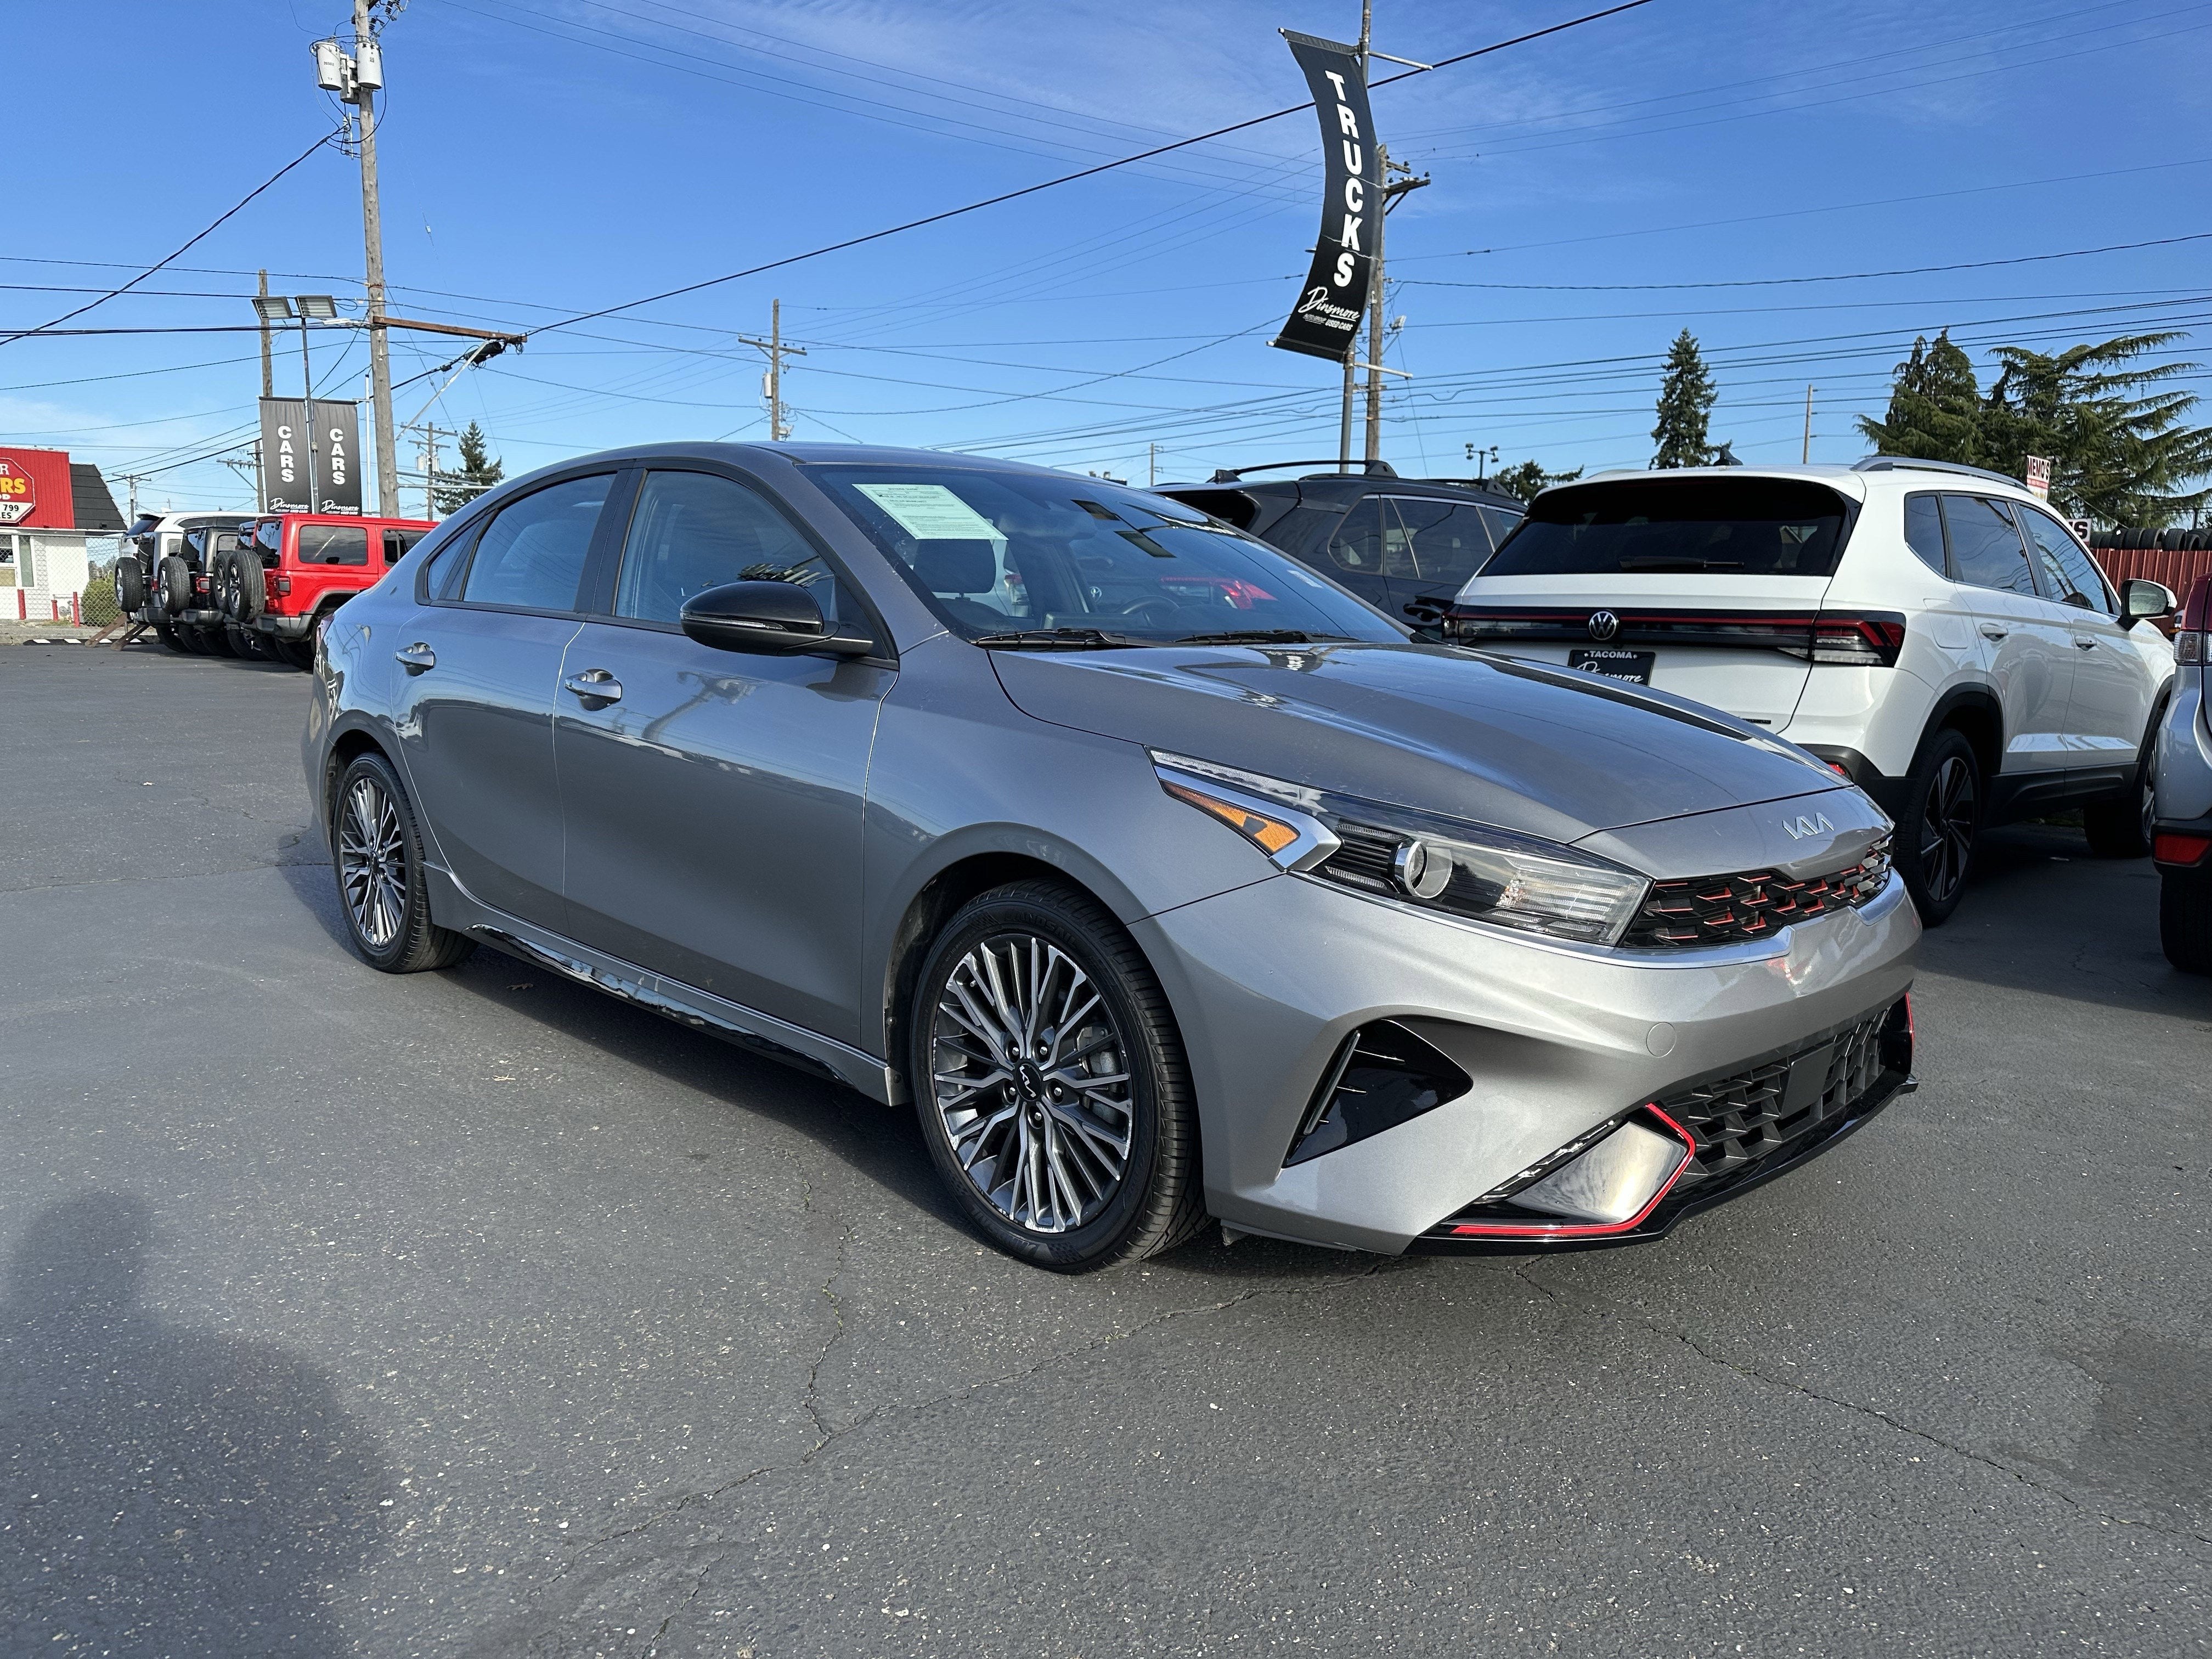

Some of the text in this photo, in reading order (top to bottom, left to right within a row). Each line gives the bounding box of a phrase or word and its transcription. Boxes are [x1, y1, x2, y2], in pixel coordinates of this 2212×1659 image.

[1325, 70, 1363, 287] TRUCKS
[1297, 286, 1361, 319] Dinsmore
[278, 425, 294, 483] CARS
[329, 428, 345, 485] CARS
[2028, 457, 2050, 481] MEMO'S
[2069, 521, 2087, 539] S
[1589, 651, 1633, 659] TACOMA
[1577, 661, 1643, 682] Dmore
[1782, 812, 1835, 840] KIA
